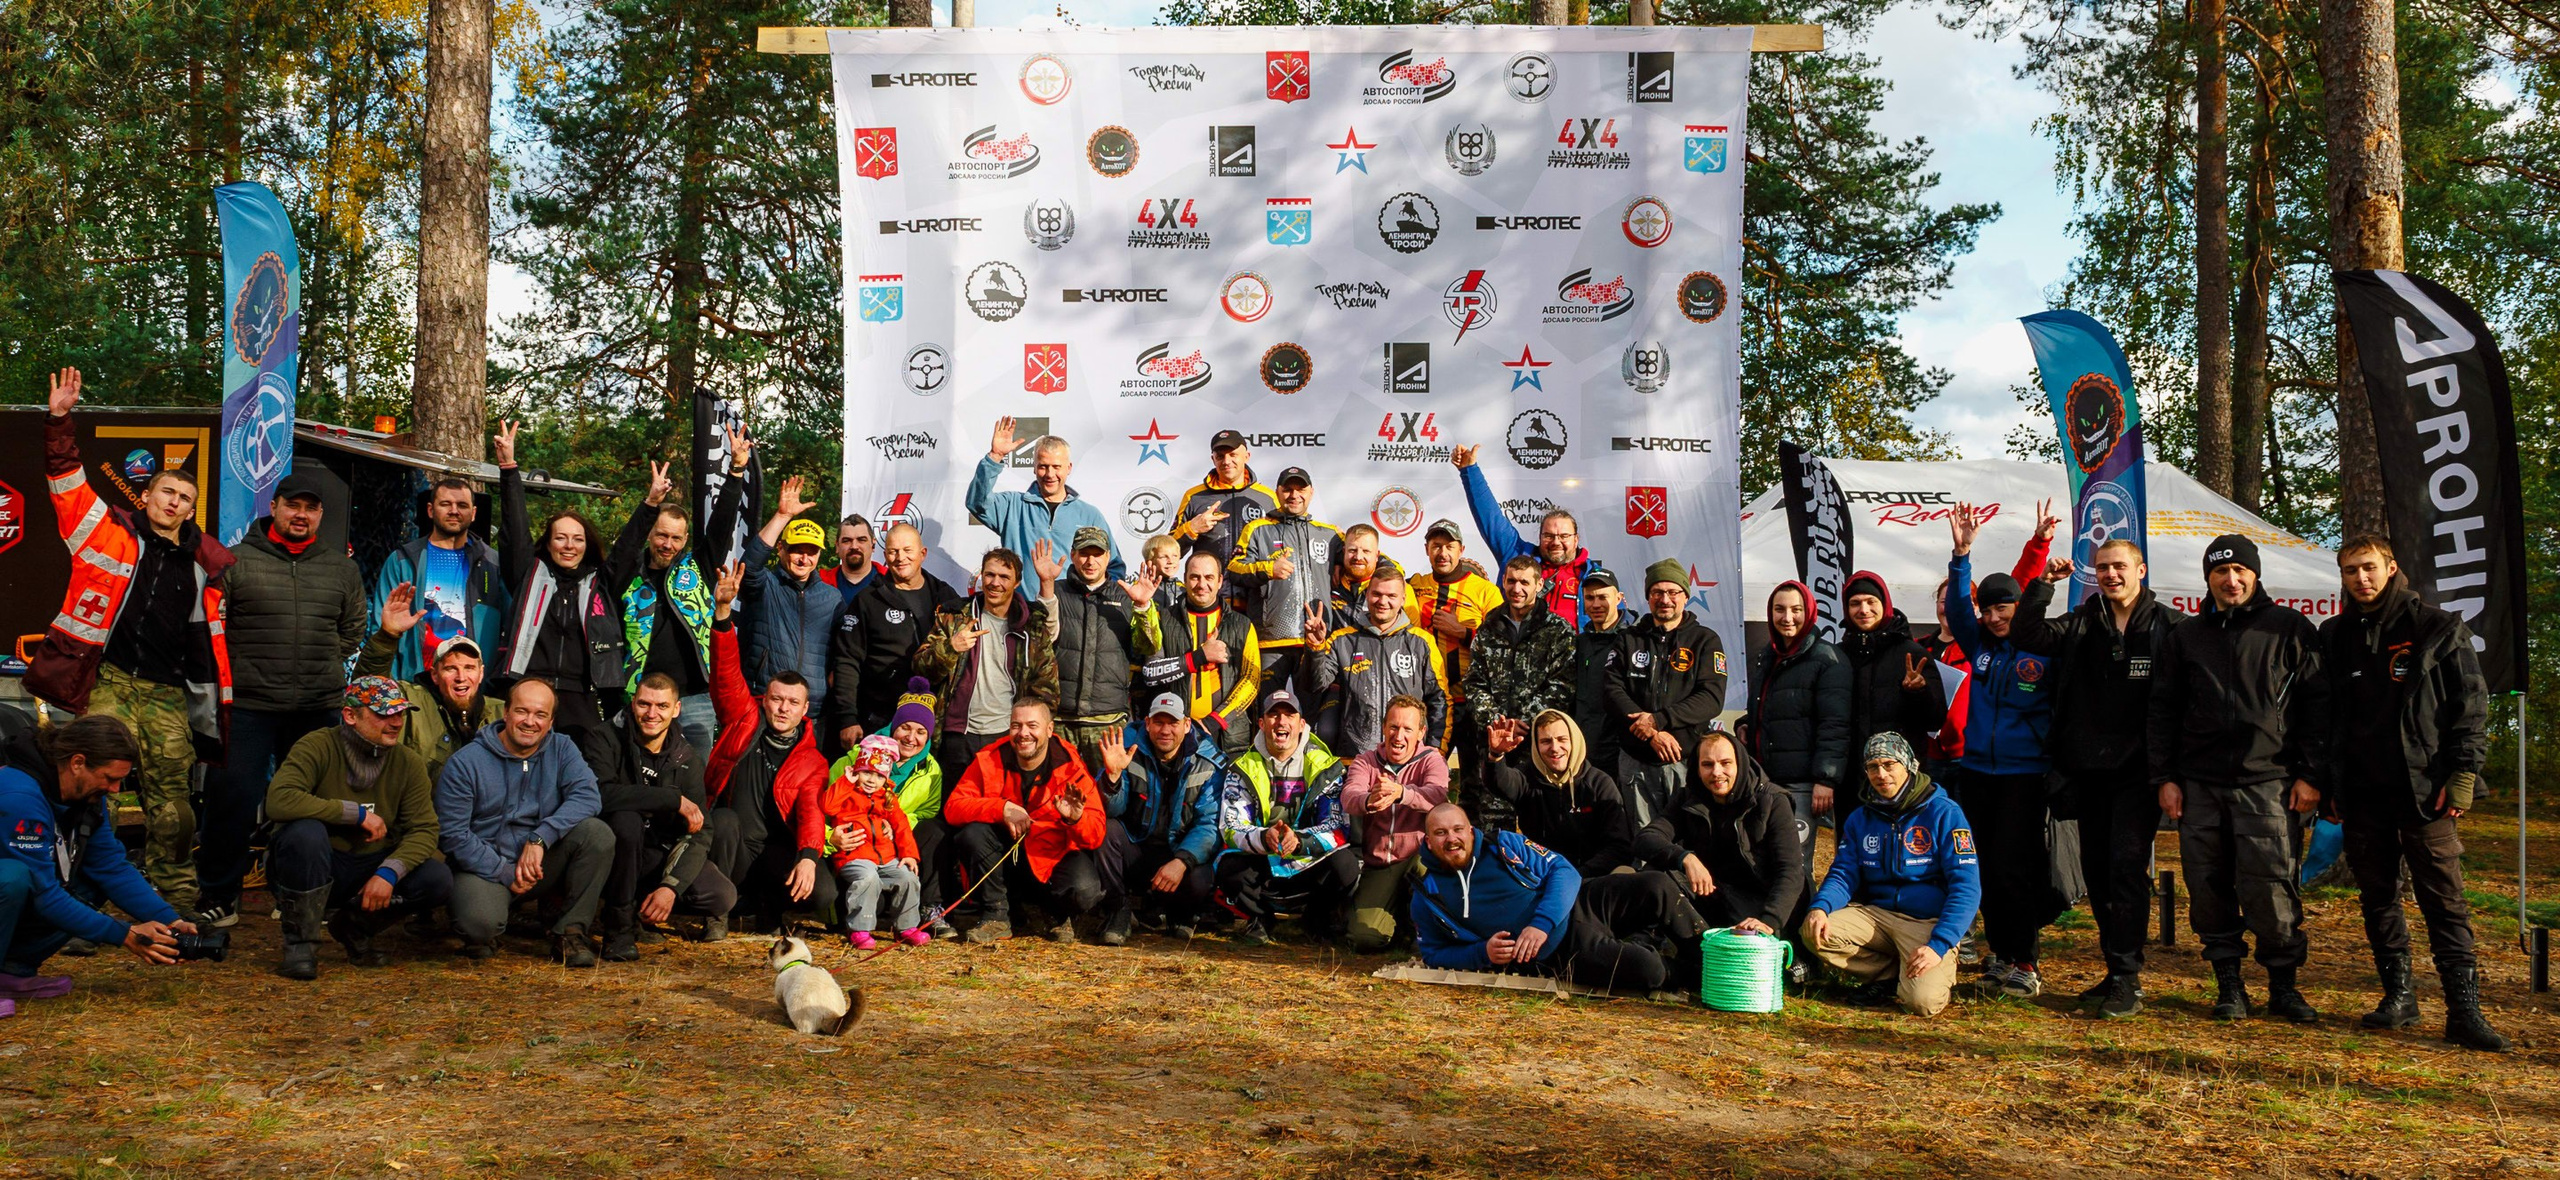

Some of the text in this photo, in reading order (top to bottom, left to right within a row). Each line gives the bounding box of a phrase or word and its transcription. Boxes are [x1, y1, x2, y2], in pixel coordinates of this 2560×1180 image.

[890, 73, 978, 87] SUPROTEC
[1148, 76, 1192, 92] России
[1362, 87, 1421, 96] АВТОСПОРТ
[1639, 92, 1670, 100] PROHIM
[1363, 98, 1391, 106] ДОСААФ
[1557, 118, 1619, 150] 4X4
[948, 162, 1006, 171] АВТОСПОРТ
[1221, 166, 1253, 174] PROHIM
[1137, 198, 1199, 229] 4X4
[895, 218, 982, 232] SUPROTEC
[1493, 216, 1581, 230] SUPROTEC
[1388, 232, 1431, 241] ЛЕНИНГРАД
[1392, 240, 1425, 249] ТРОФИ
[1080, 289, 1168, 303] SUPROTEC
[975, 300, 1019, 310] ЛЕНИНГРАД
[1334, 296, 1377, 310] России
[979, 308, 1013, 317] ТРОФИ
[1542, 305, 1600, 315] АВТОСПОРТ
[1542, 316, 1570, 324] ДОСААФ
[1120, 379, 1178, 388] АВТОСПОРТ
[1395, 382, 1427, 390] PROHIM
[1377, 412, 1440, 443] 4X4
[1628, 437, 1712, 453] SUPROTEC
[884, 446, 925, 461] России
[1515, 448, 1559, 458] ЛЕНИНГРАД
[1015, 457, 1035, 465] PROH
[1519, 456, 1554, 466] ТРОФИ
[1844, 491, 1957, 505] PROTEC
[2208, 549, 2235, 564] NEO
[1161, 672, 1185, 685] TEAM
